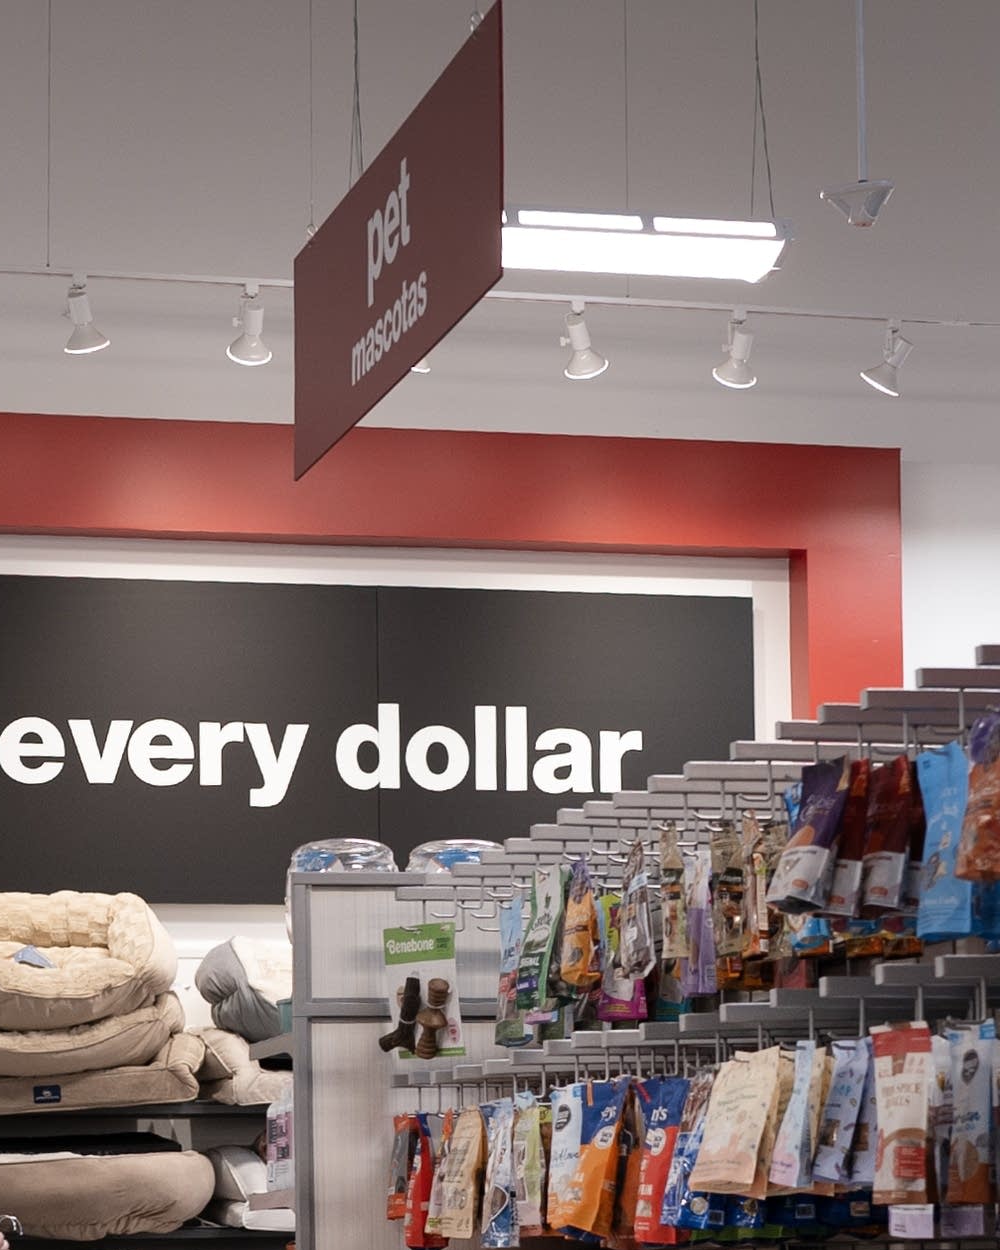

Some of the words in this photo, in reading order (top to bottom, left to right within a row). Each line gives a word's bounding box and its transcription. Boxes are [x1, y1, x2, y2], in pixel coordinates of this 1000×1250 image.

[366, 157, 411, 308] pet
[351, 271, 428, 387] mascotas
[335, 703, 643, 794] dollar
[386, 938, 435, 955] Benebone
